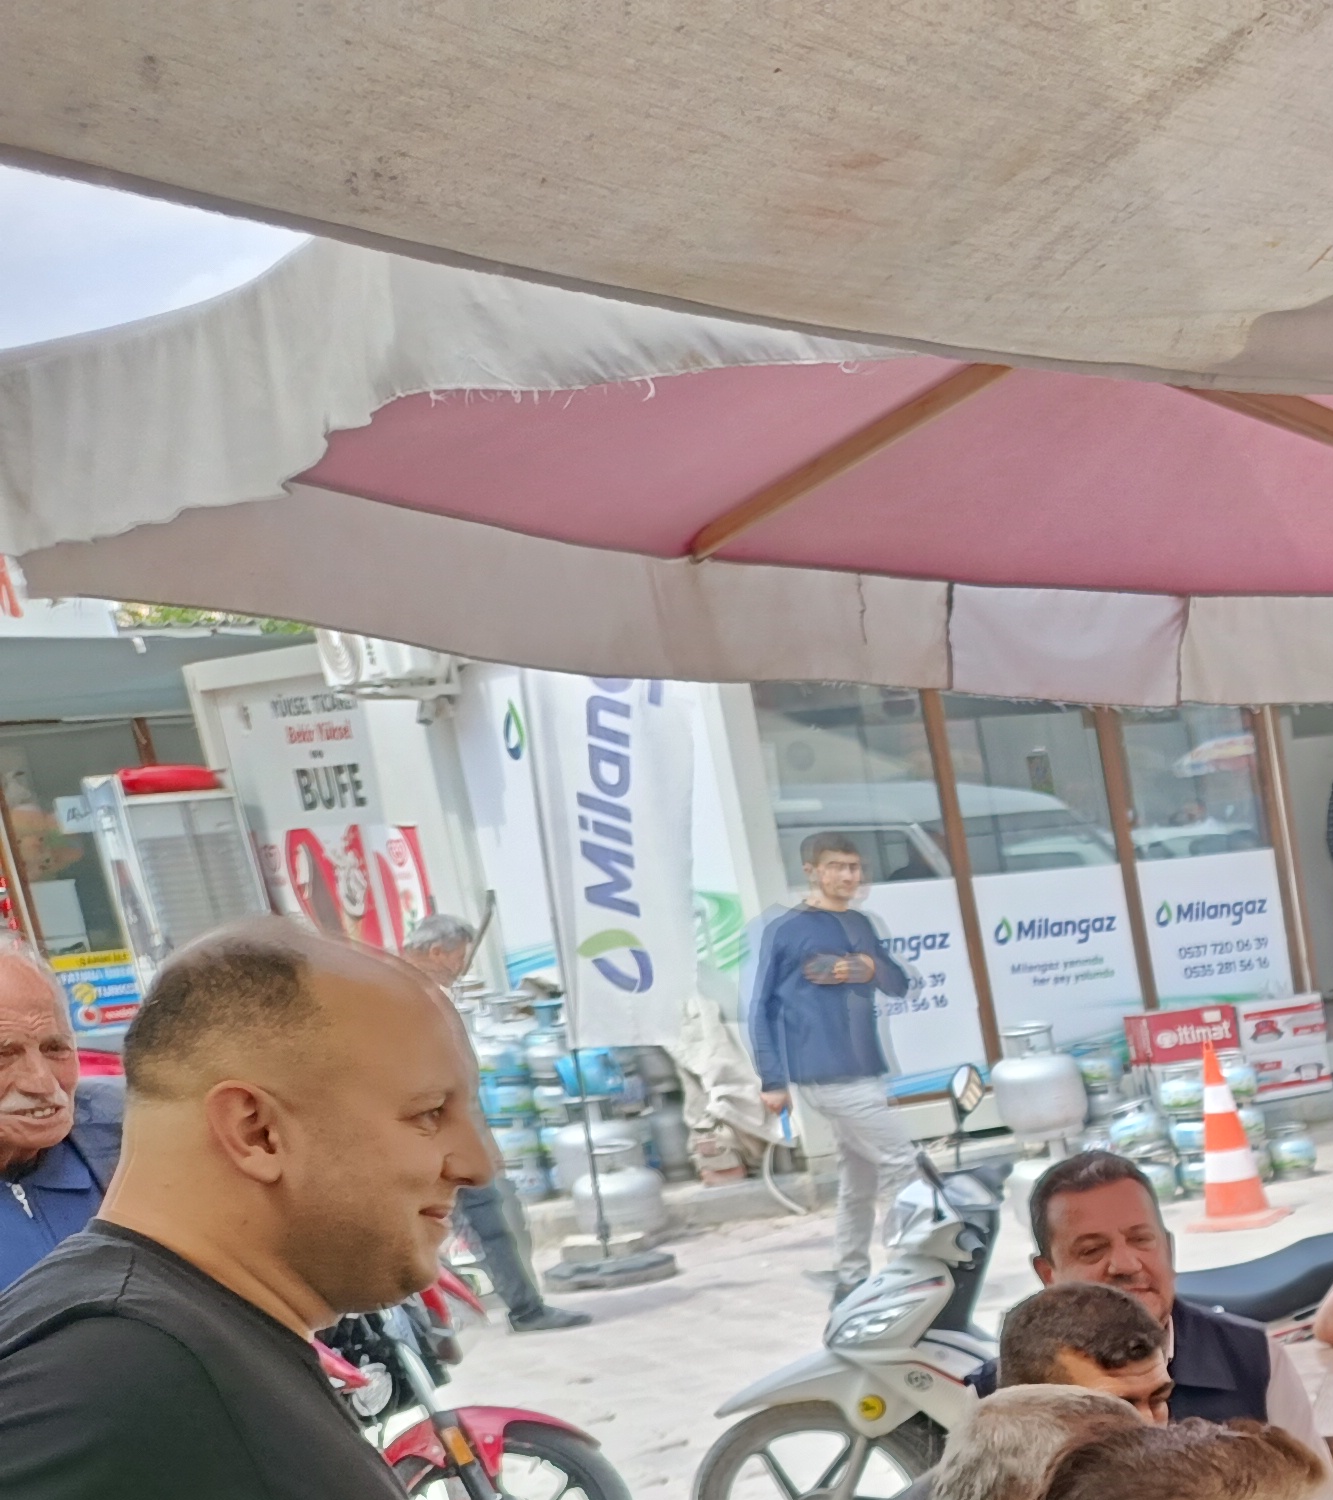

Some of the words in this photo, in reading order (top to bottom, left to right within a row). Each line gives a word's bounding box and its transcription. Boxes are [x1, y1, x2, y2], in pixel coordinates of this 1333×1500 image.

[1176, 898, 1267, 925] Milangaz
[1016, 915, 1117, 944] Milangaz
[1177, 945, 1208, 960] 0537
[1210, 940, 1233, 955] 720
[1236, 938, 1252, 952] 06
[1254, 936, 1269, 950] 39
[1183, 965, 1215, 979] 0535
[1216, 962, 1237, 975] 281
[1239, 959, 1255, 972] 56
[1256, 956, 1270, 969] 16
[911, 995, 931, 1012] 56
[932, 993, 948, 1009] 16
